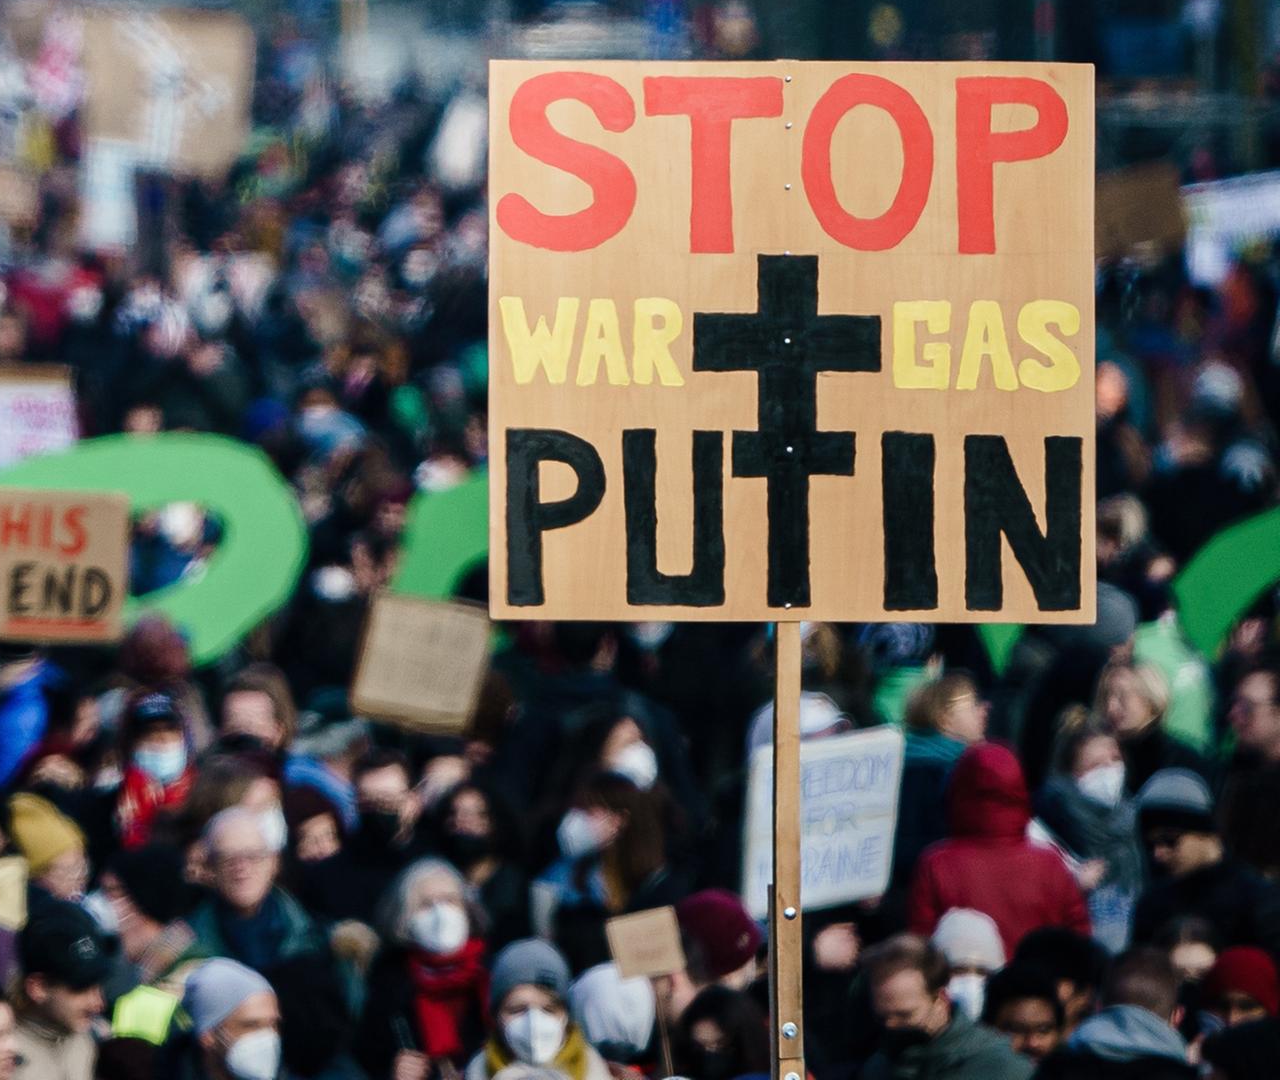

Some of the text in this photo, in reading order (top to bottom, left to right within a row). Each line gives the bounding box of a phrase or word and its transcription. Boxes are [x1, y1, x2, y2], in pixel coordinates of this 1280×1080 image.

[496, 71, 1069, 254] STOP
[499, 297, 1081, 392] WAR GAS
[506, 428, 1082, 611] PUTIN
[6, 560, 113, 619] END
